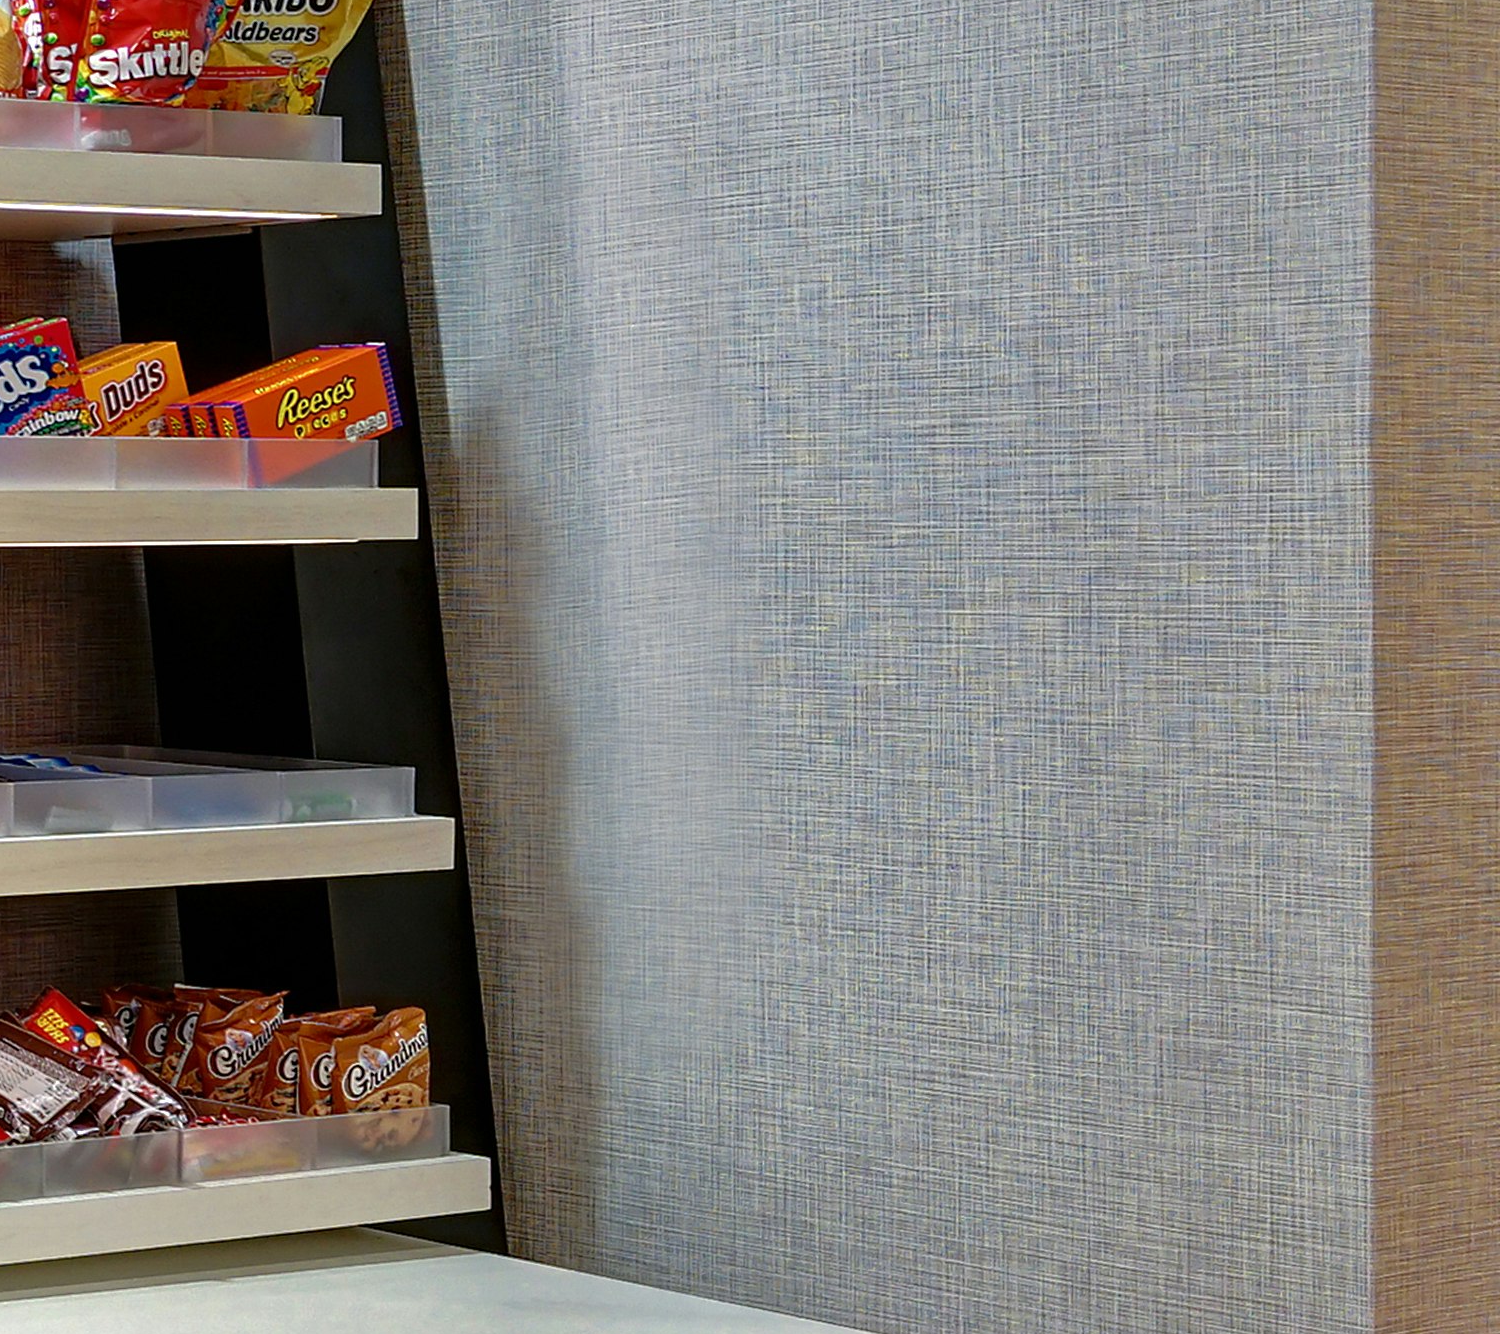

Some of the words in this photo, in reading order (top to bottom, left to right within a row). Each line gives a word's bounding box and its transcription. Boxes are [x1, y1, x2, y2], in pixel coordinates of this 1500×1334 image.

[88, 41, 205, 89] Skittle
[102, 359, 166, 422] Duds
[277, 375, 356, 429] Reese's
